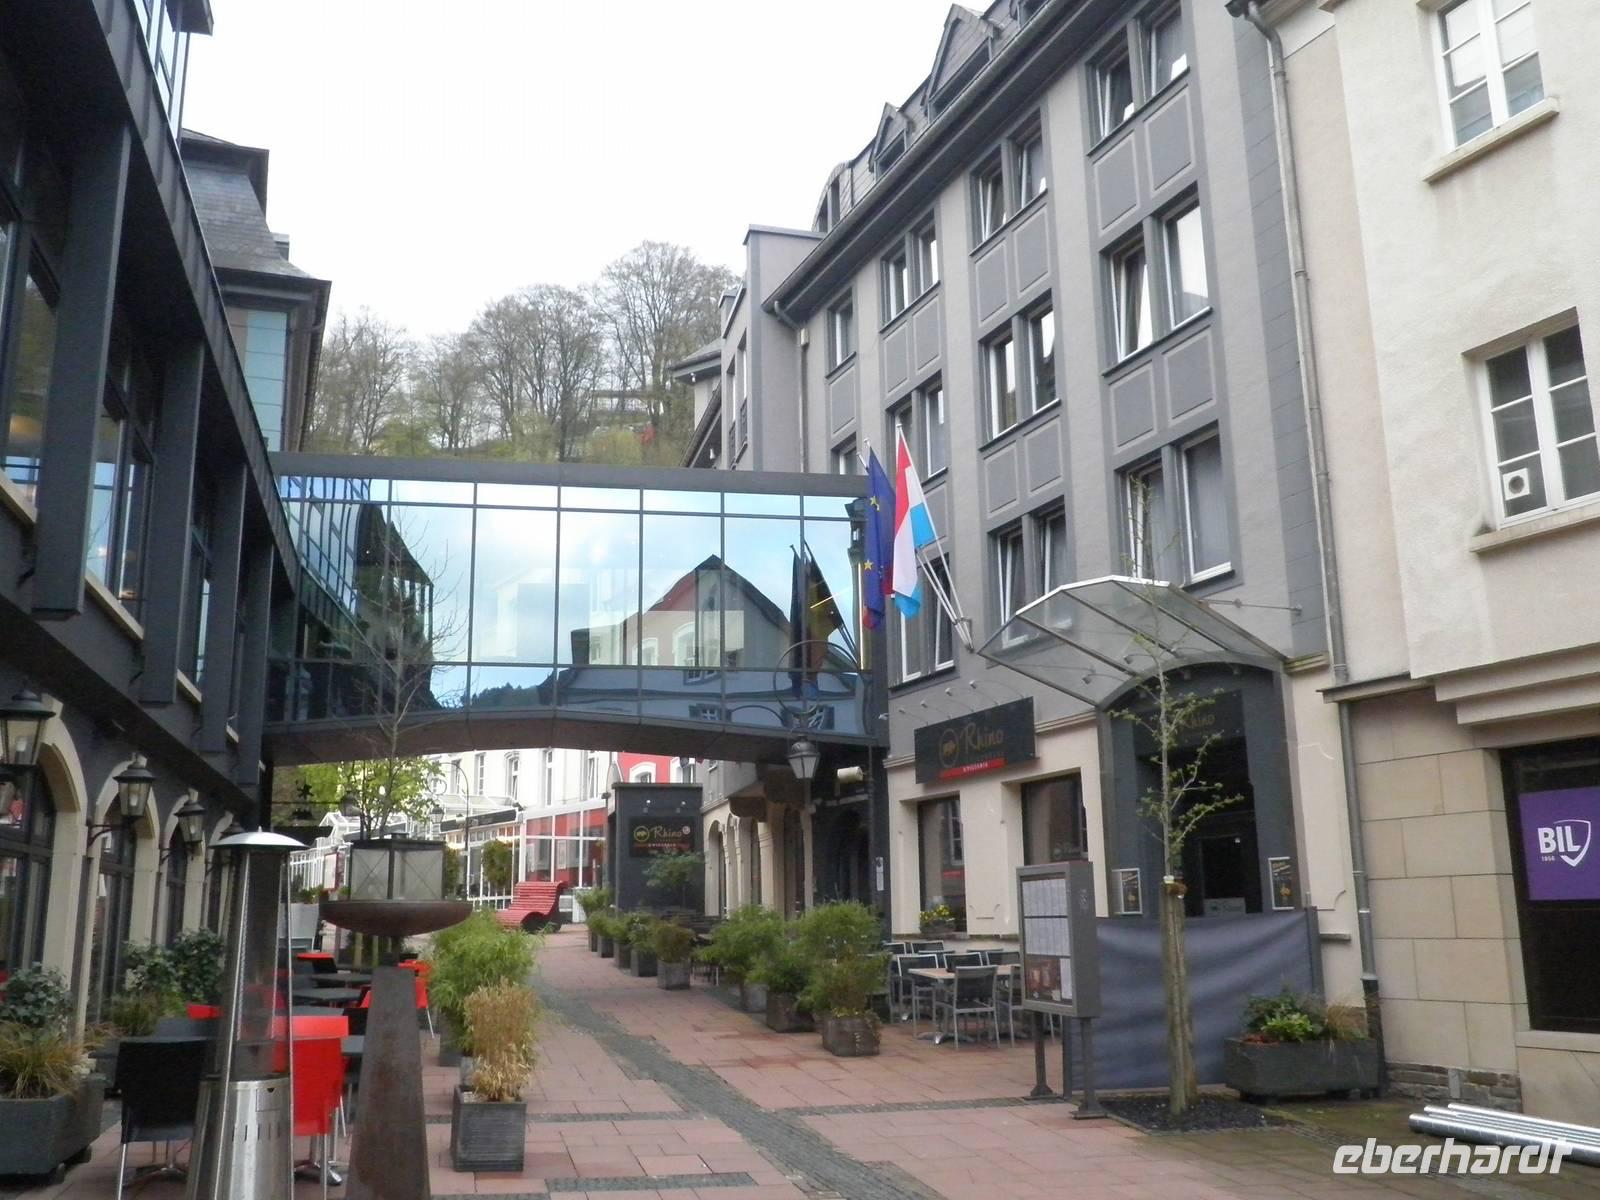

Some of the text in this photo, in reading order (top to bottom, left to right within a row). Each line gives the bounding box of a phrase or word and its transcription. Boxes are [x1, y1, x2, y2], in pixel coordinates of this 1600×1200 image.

[961, 721, 1005, 755] Rhino
[649, 825, 682, 838] Rhino
[1537, 825, 1581, 854] BIL
